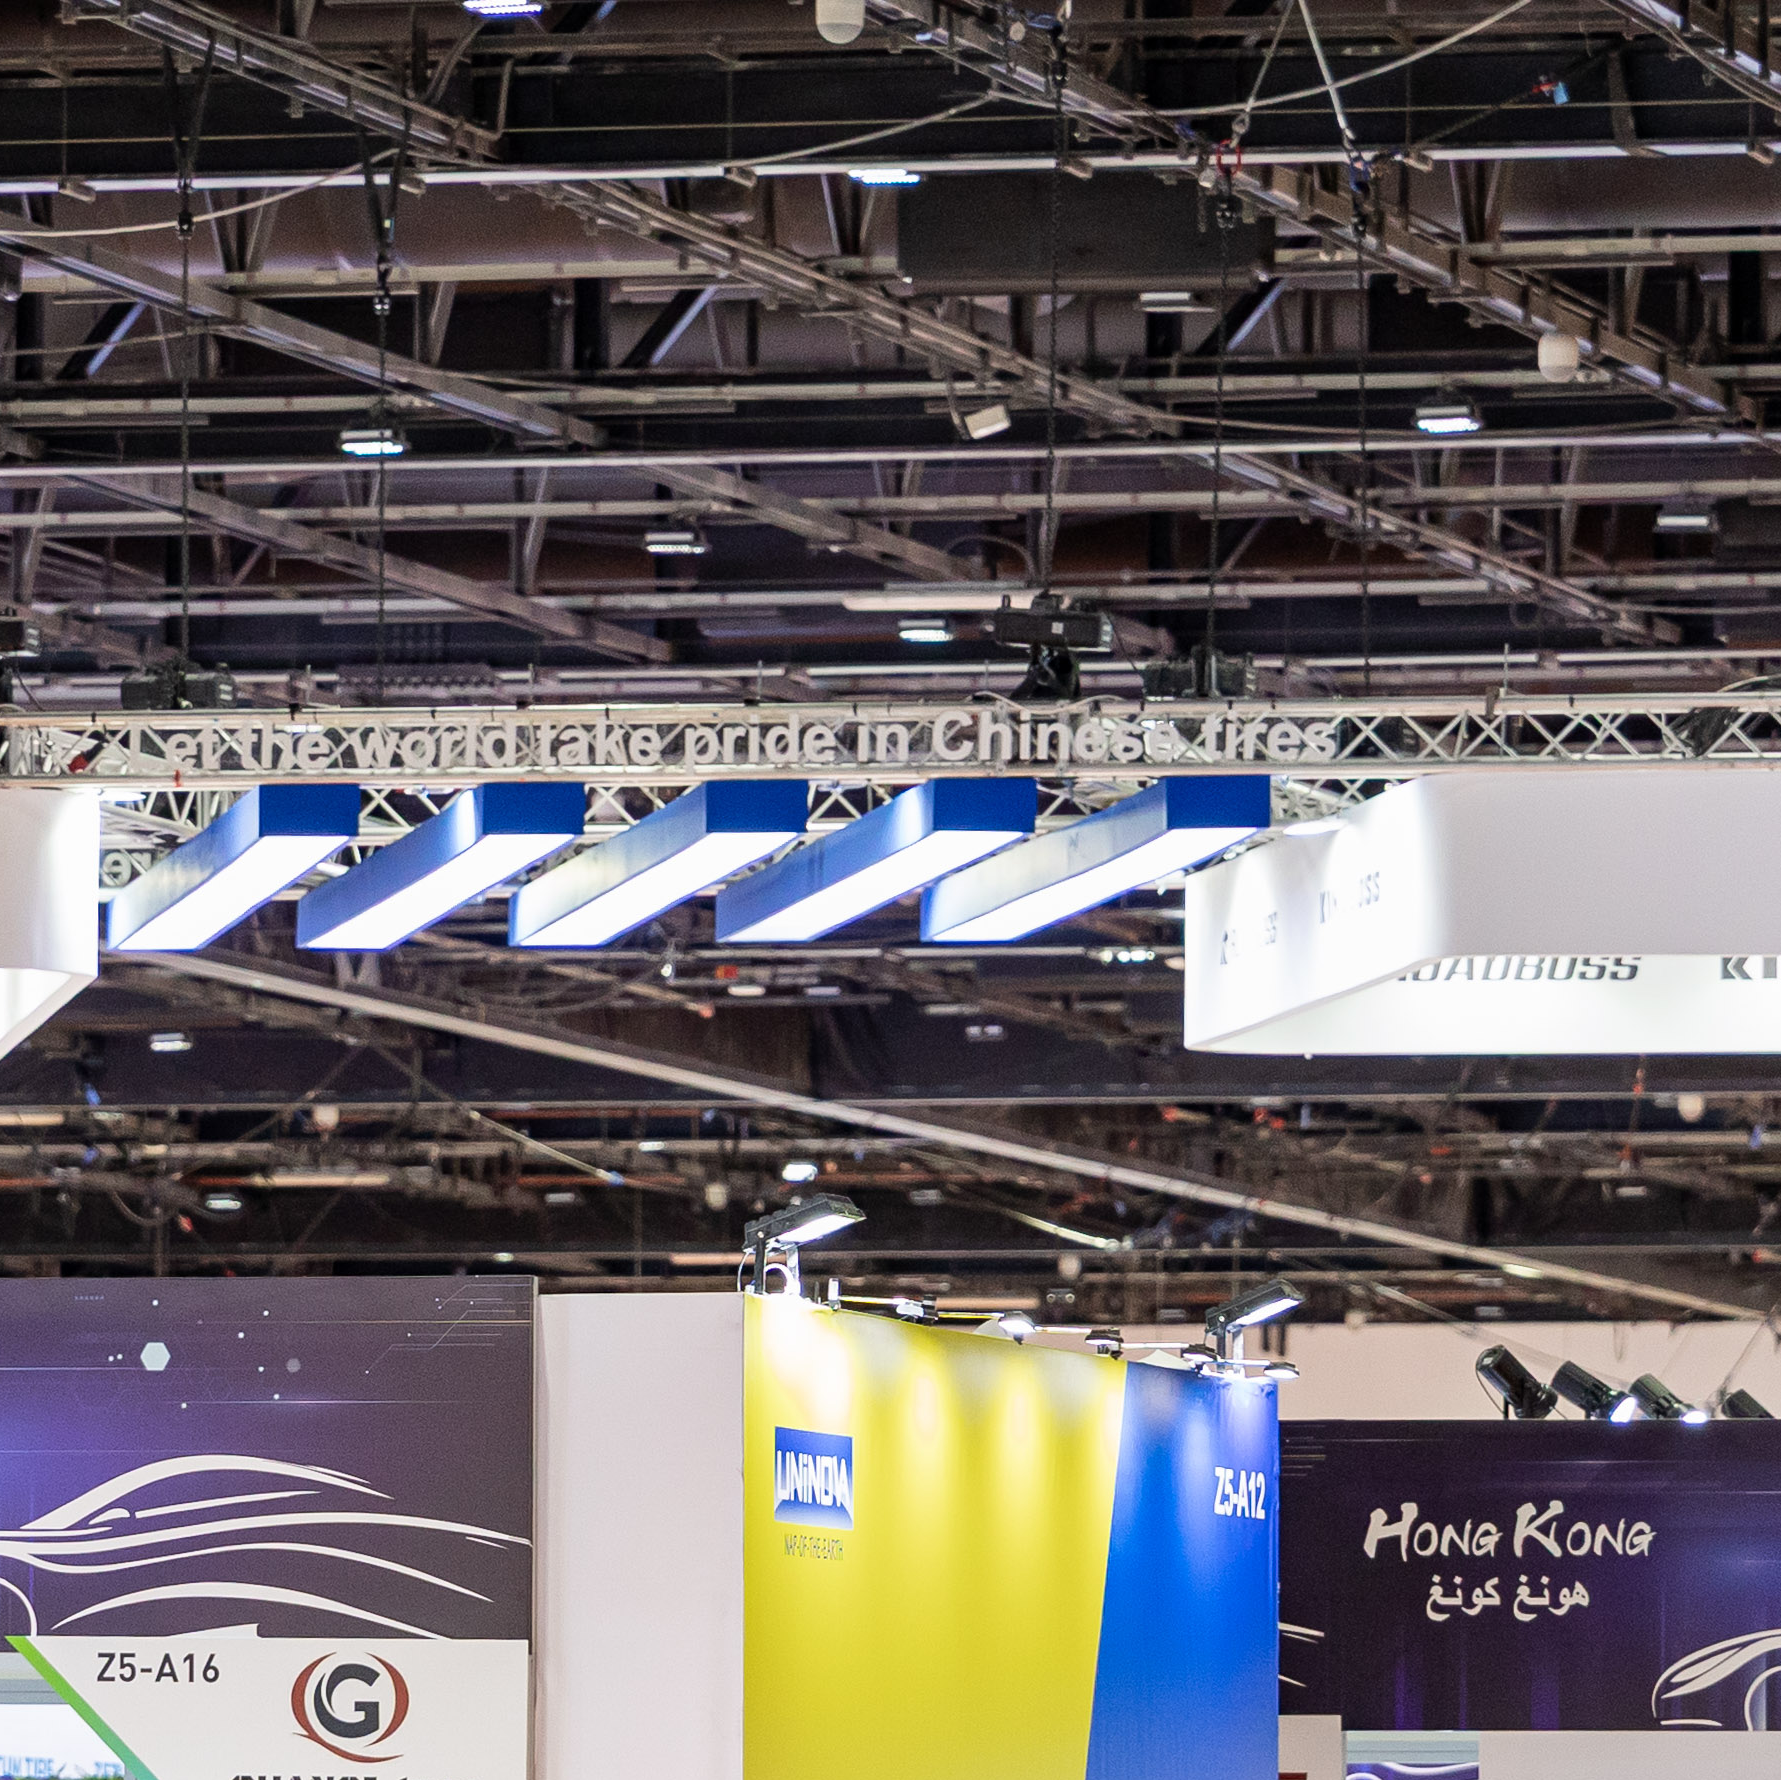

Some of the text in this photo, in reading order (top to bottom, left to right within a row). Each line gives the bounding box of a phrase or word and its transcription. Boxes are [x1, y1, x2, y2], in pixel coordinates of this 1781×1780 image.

[235, 723, 330, 769] the
[352, 721, 518, 768] world
[537, 720, 661, 766] take
[684, 713, 835, 770] pride
[856, 714, 910, 762] in
[932, 711, 1178, 762] Chinese
[1205, 711, 1337, 761] tires
[1214, 1467, 1266, 1519] Z5-A12
[1364, 1500, 1657, 1562] HONG KONG
[1426, 1574, 1590, 1622] هونغ كونغ
[96, 1652, 221, 1684] Z5-A16
